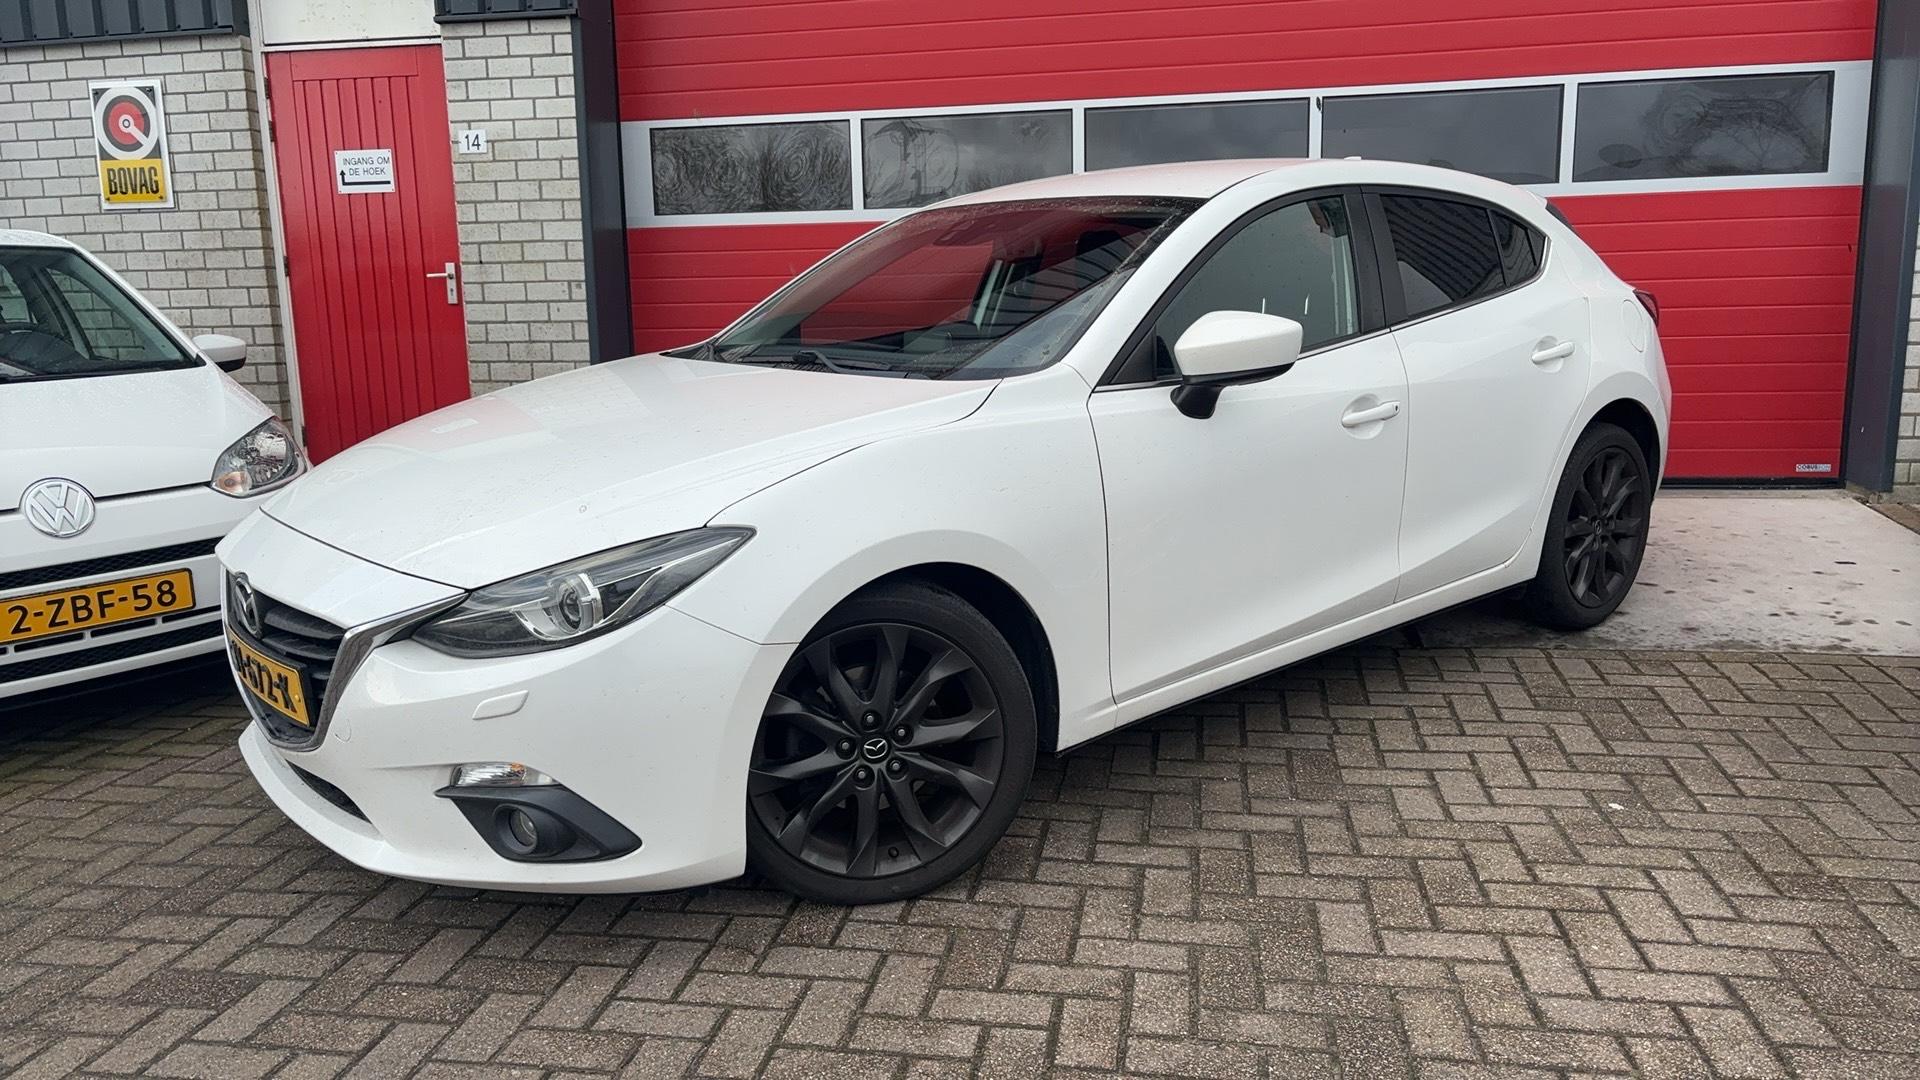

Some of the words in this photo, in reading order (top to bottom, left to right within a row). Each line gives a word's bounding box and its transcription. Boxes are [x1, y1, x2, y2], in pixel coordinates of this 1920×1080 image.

[464, 134, 481, 151] 14
[342, 156, 375, 166] INGANG
[376, 156, 391, 165] OM
[348, 168, 360, 176] DE
[362, 167, 386, 176] HOEK
[106, 167, 160, 196] BOVAG
[7, 580, 177, 635] 2-ZBF-58
